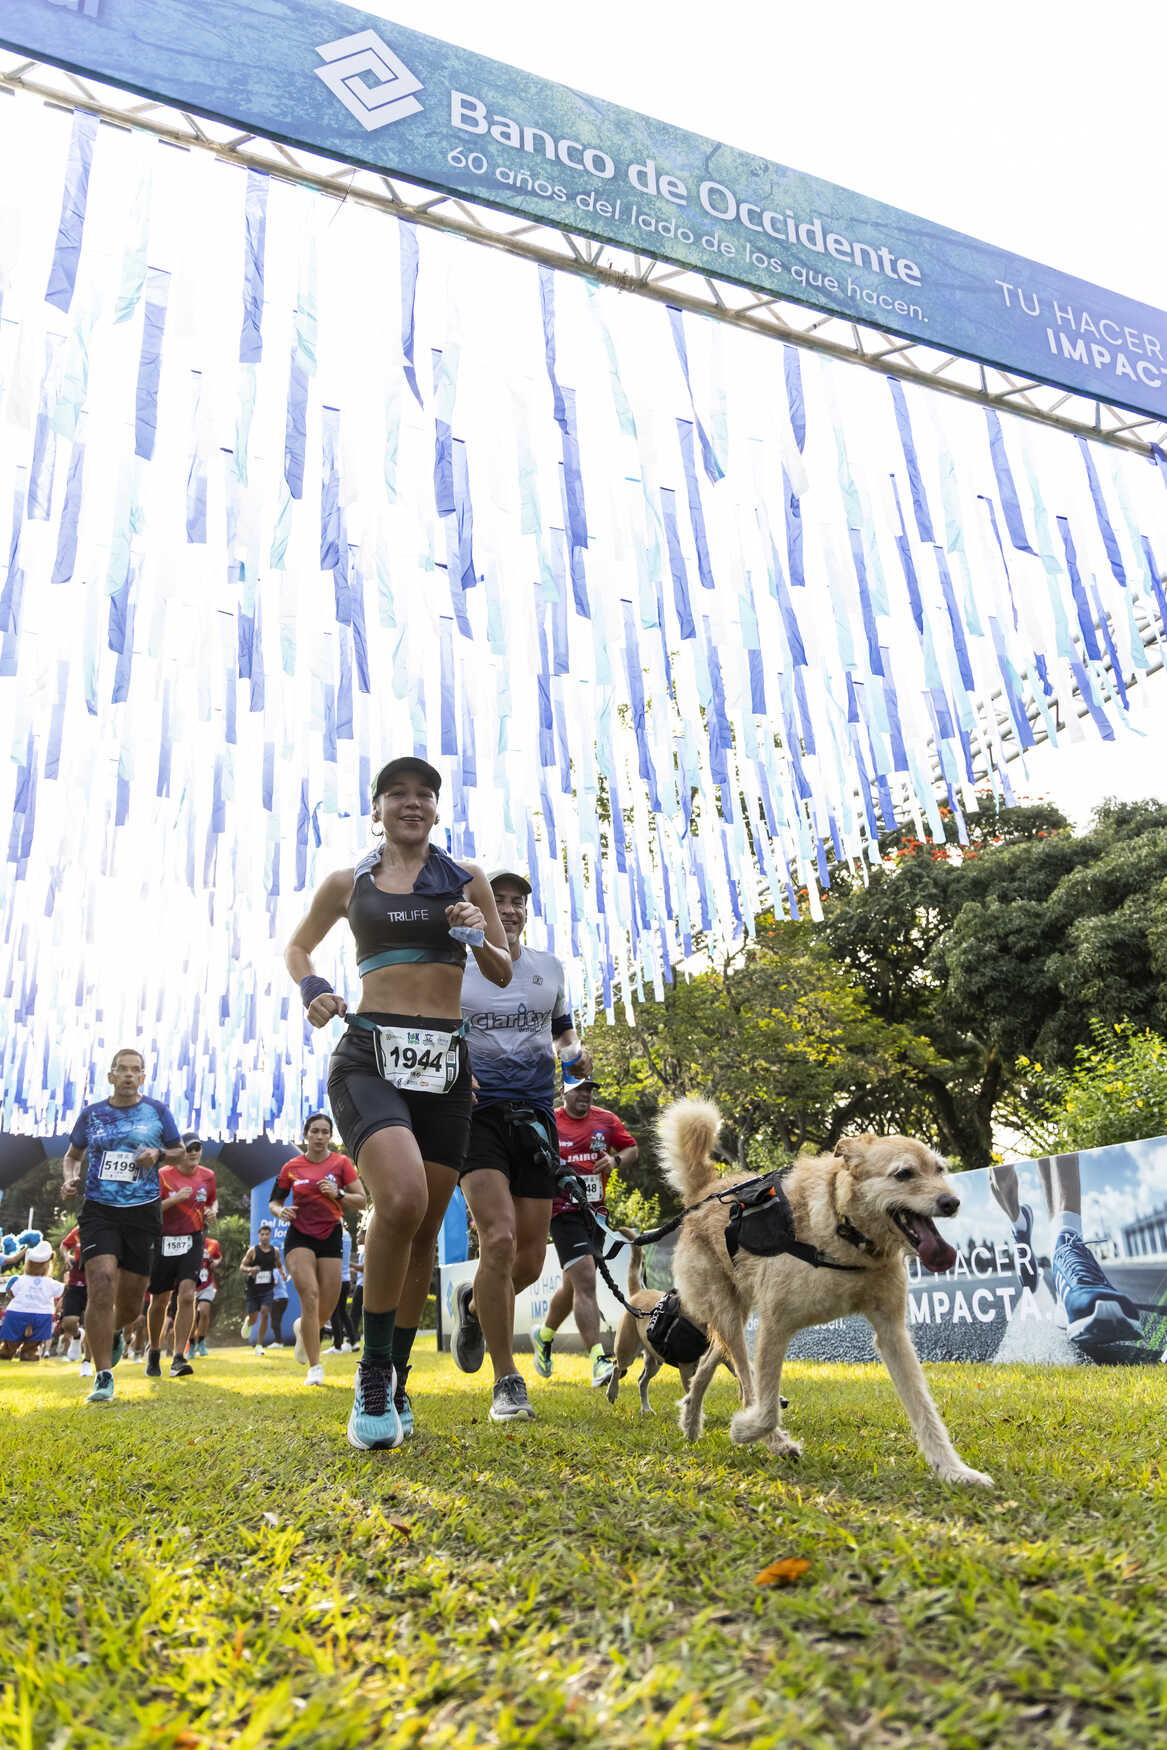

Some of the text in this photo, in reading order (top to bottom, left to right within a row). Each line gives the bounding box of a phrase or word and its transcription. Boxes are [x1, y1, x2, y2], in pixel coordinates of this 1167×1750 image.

[450, 90, 922, 287] Banco de Occidente
[447, 146, 929, 323] 60 años del lado de los que hacen.
[995, 279, 1164, 361] TU HACER
[1046, 327, 1167, 388] IMPAC
[387, 909, 429, 922] TRILIFE
[471, 1002, 552, 1032] Clarity
[390, 1046, 443, 1073] 1944
[104, 1160, 136, 1172] 5199
[586, 1183, 597, 1193] 48
[531, 1299, 549, 1319] IMP
[908, 1286, 1052, 1324] MPACTA.
